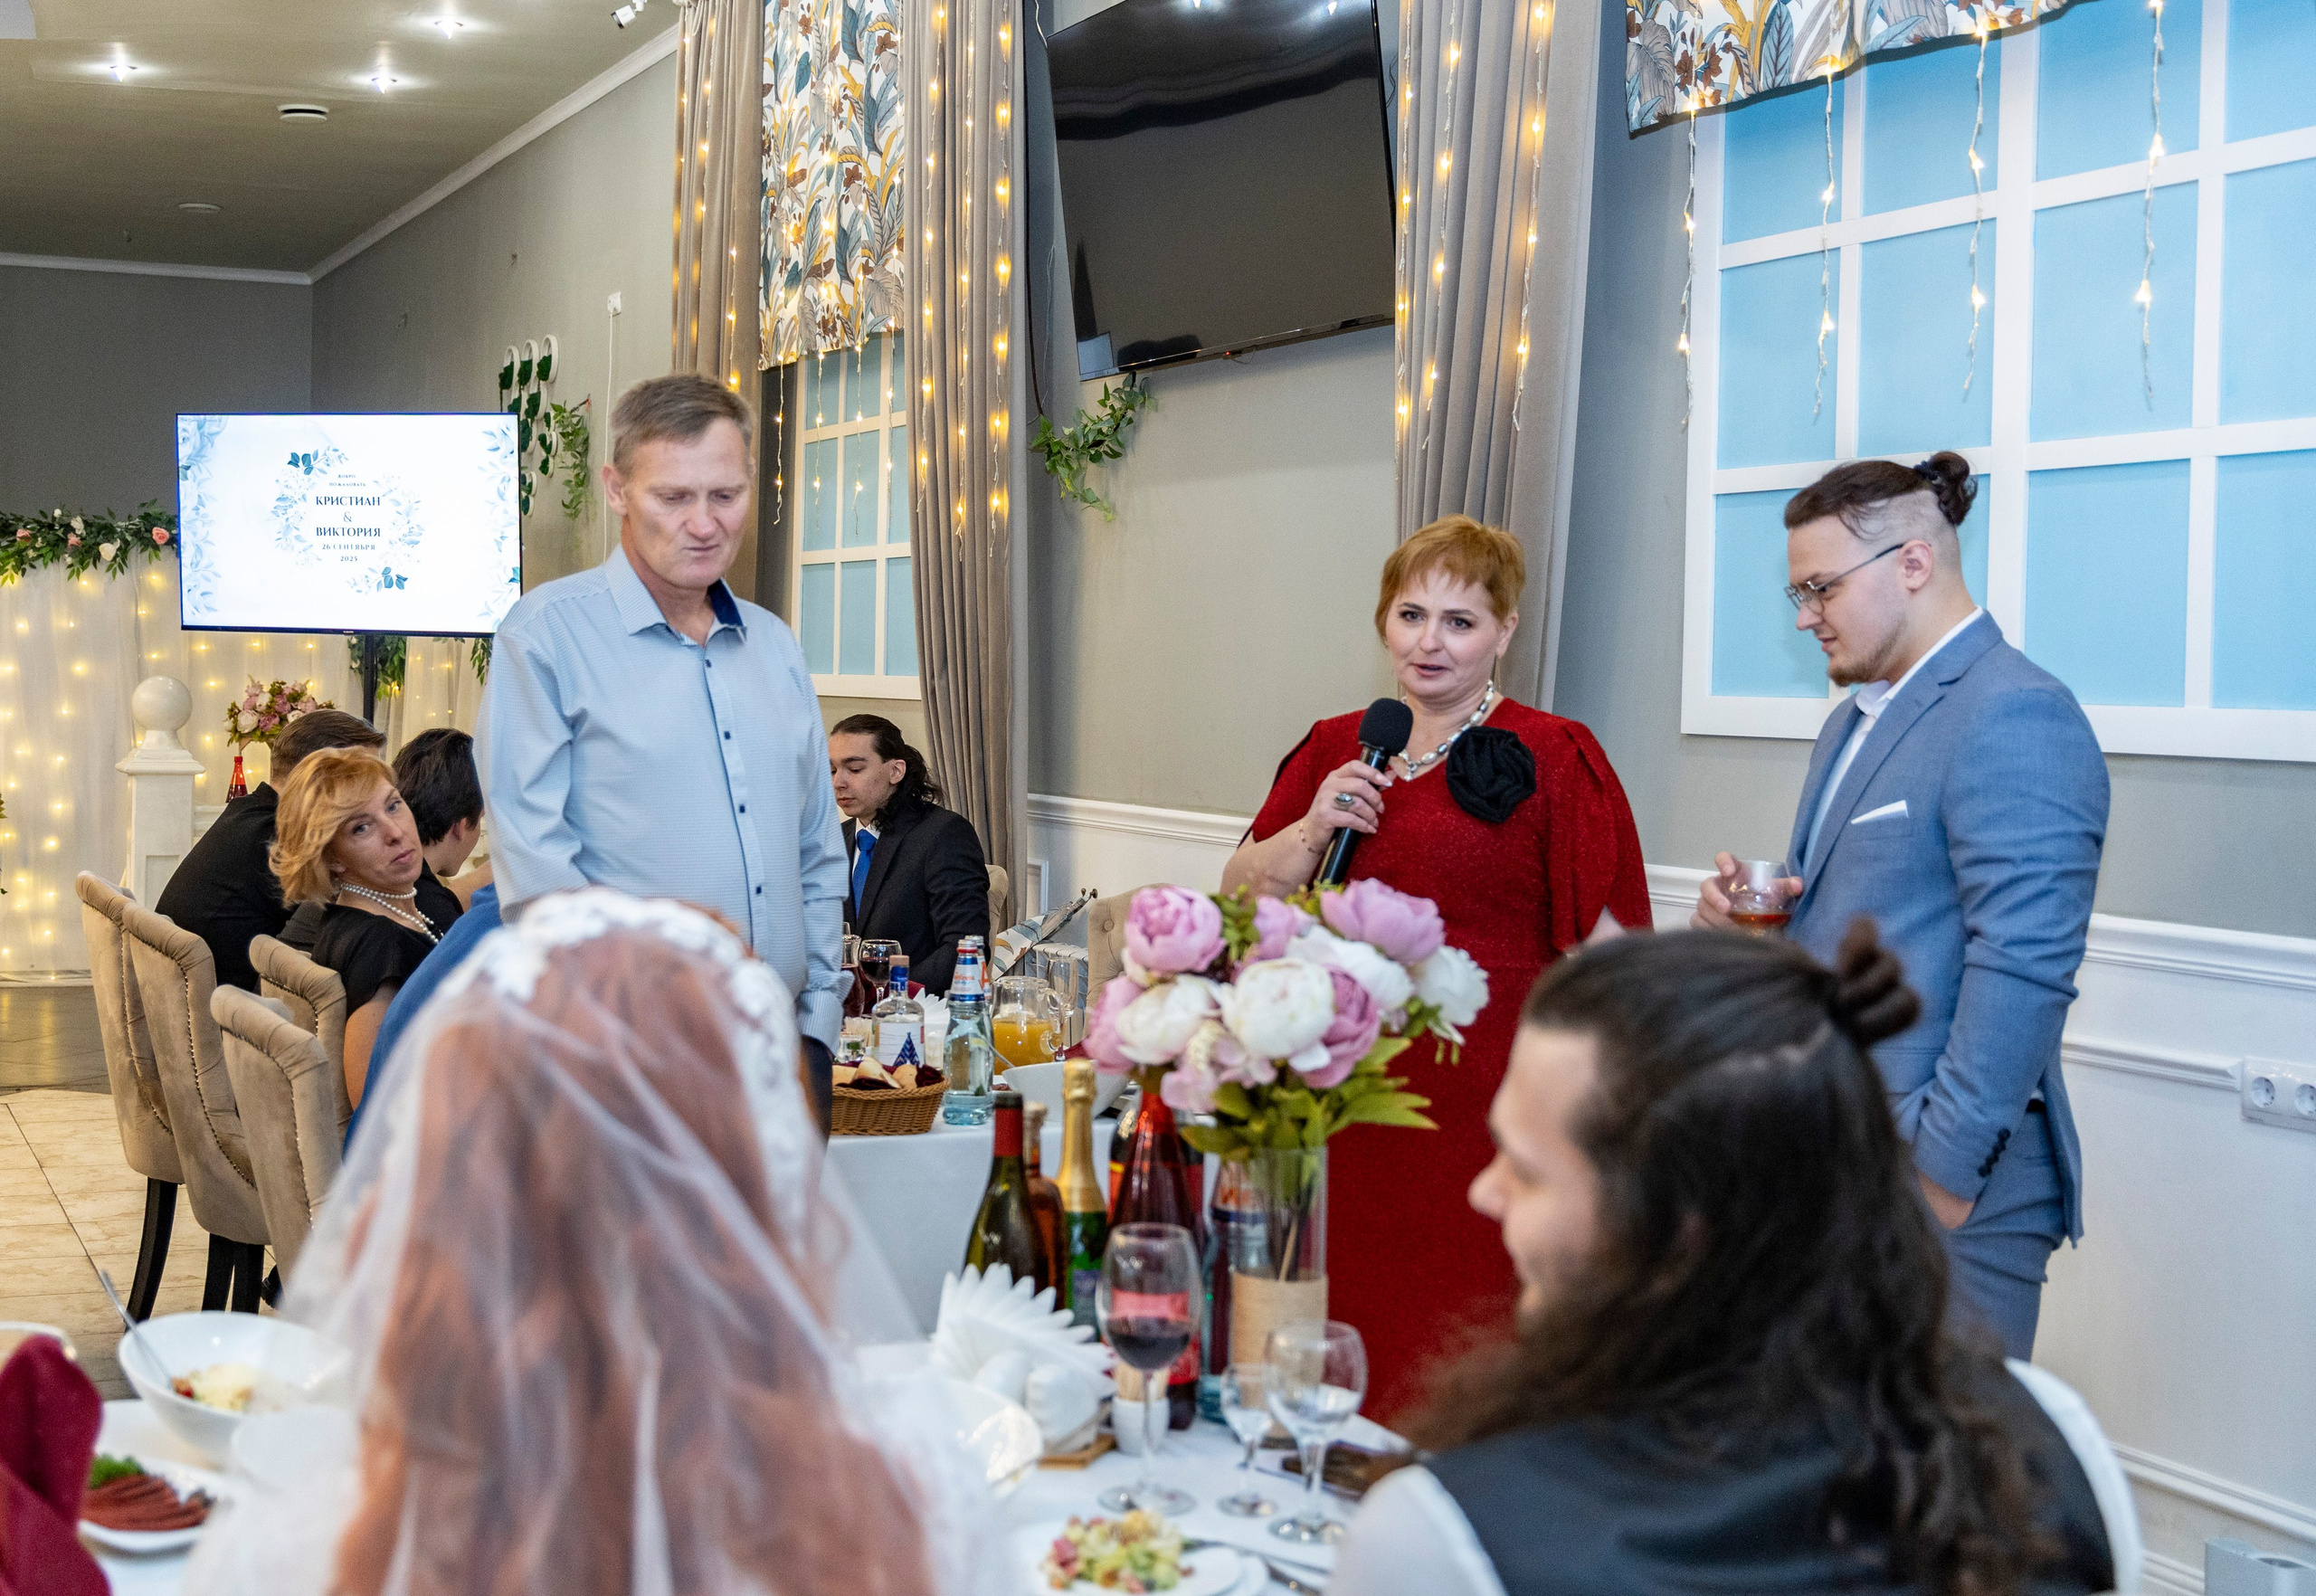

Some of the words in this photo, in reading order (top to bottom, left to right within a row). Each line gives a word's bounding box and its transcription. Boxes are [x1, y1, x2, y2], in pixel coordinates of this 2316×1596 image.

[316, 496, 381, 506] КРИСТИАН
[343, 511, 352, 523] &
[316, 527, 381, 537] ВИКТОРИЯ
